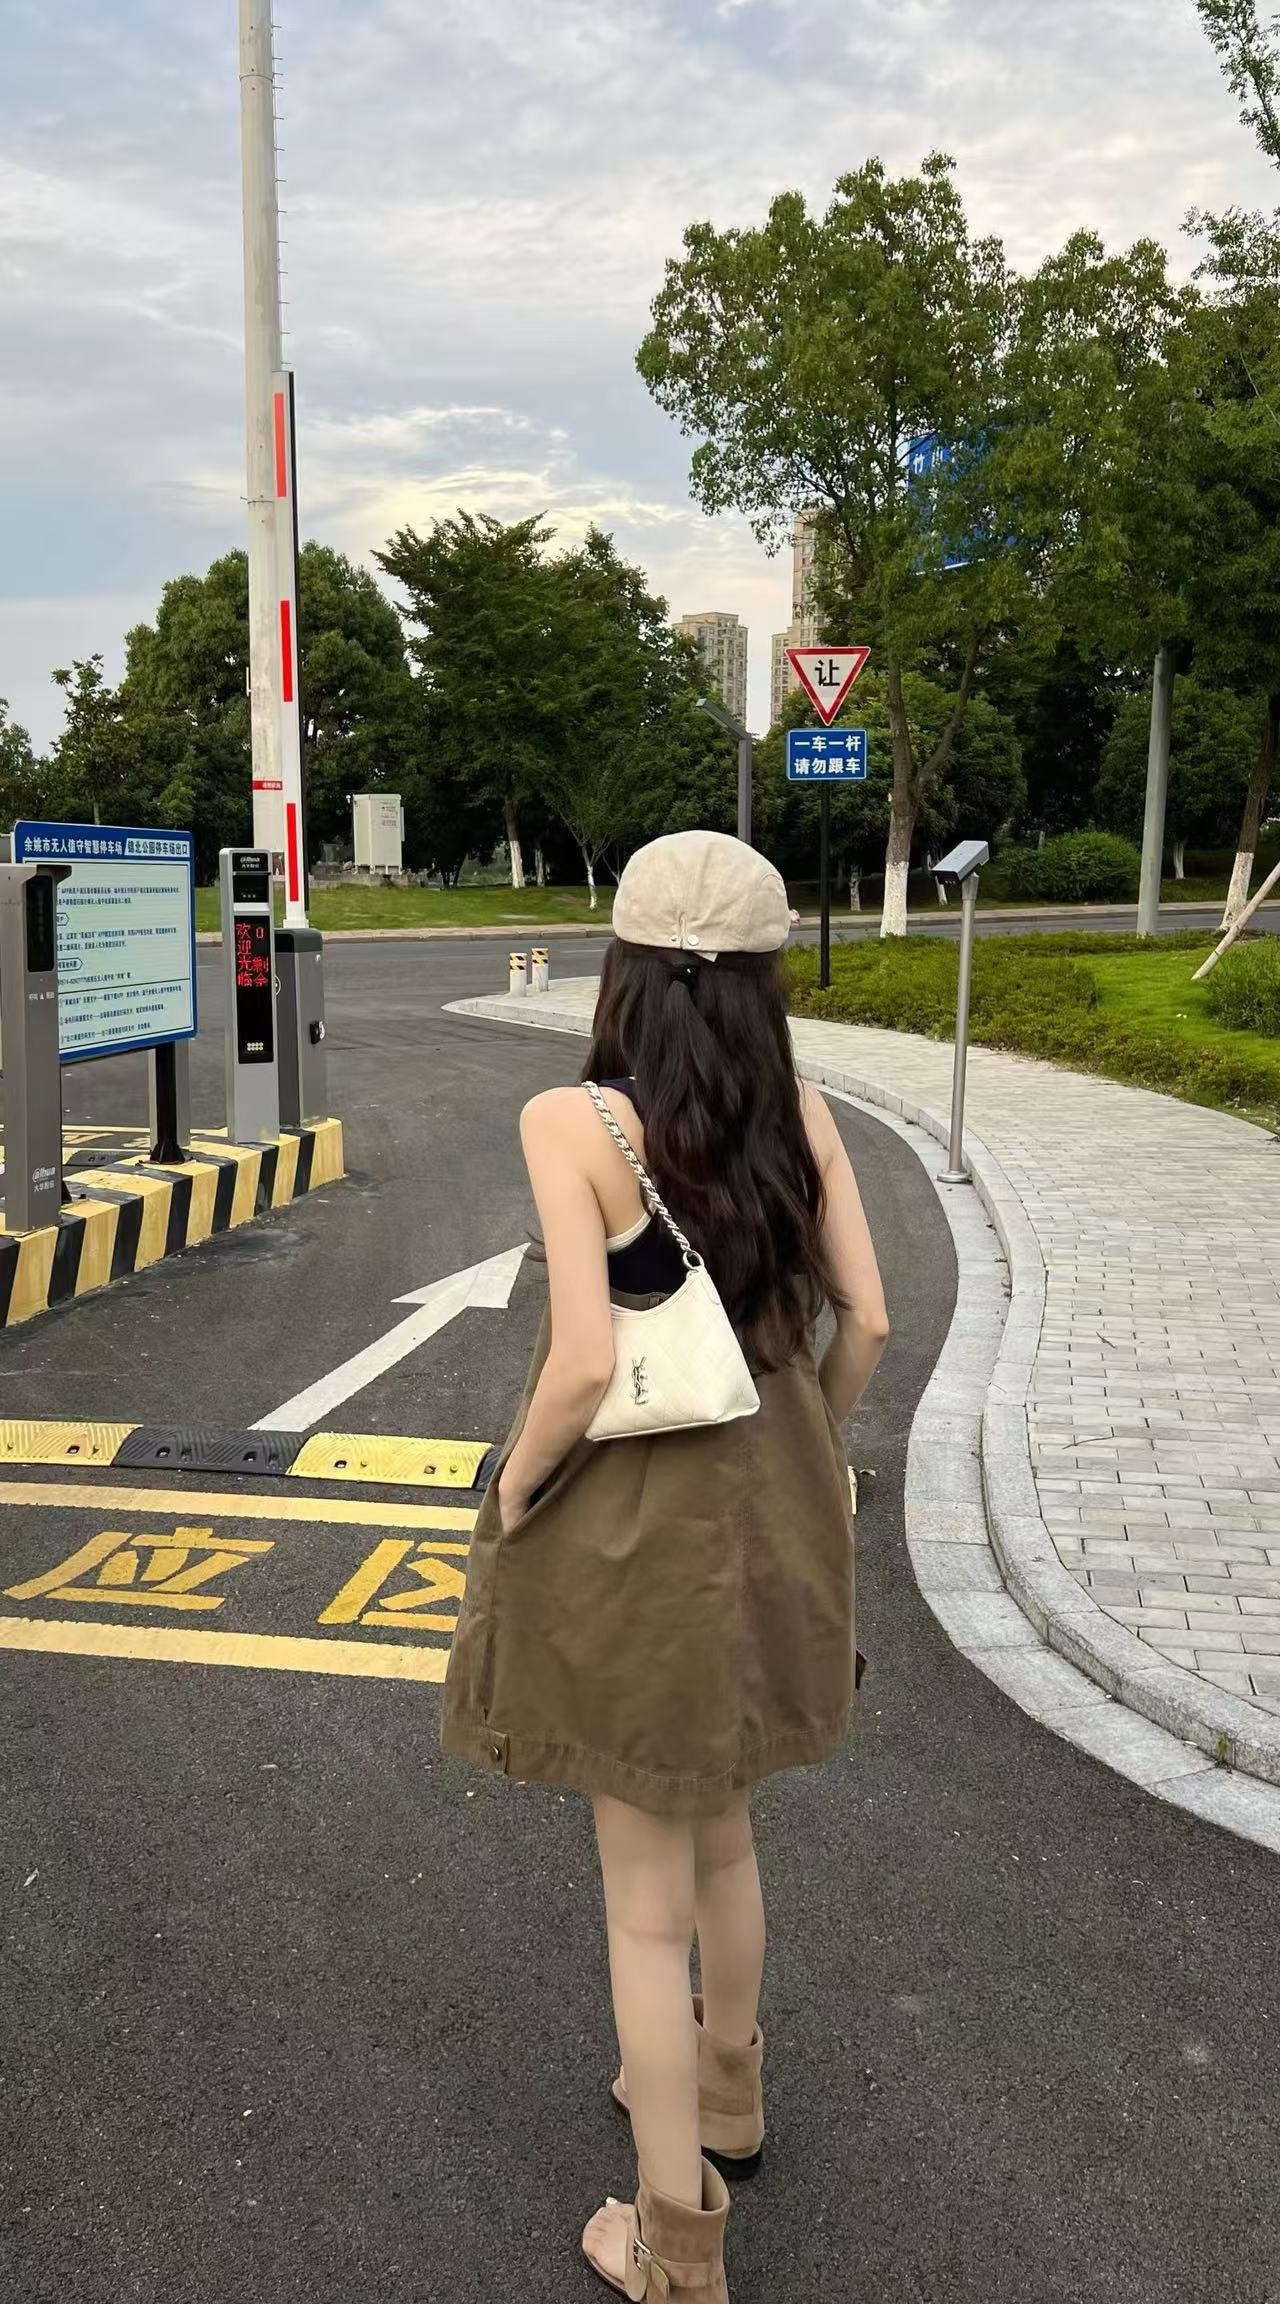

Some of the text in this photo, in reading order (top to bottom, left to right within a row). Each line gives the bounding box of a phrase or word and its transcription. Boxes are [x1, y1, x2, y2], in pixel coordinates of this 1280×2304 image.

[814, 659, 840, 686] 让
[794, 736, 861, 752] 一车一杆
[794, 757, 861, 774] 请勿跟车
[24, 836, 122, 855] 余姚市无人值守智慧停车场
[236, 922, 253, 986] 欢迎光临
[253, 956, 269, 986] 剩余
